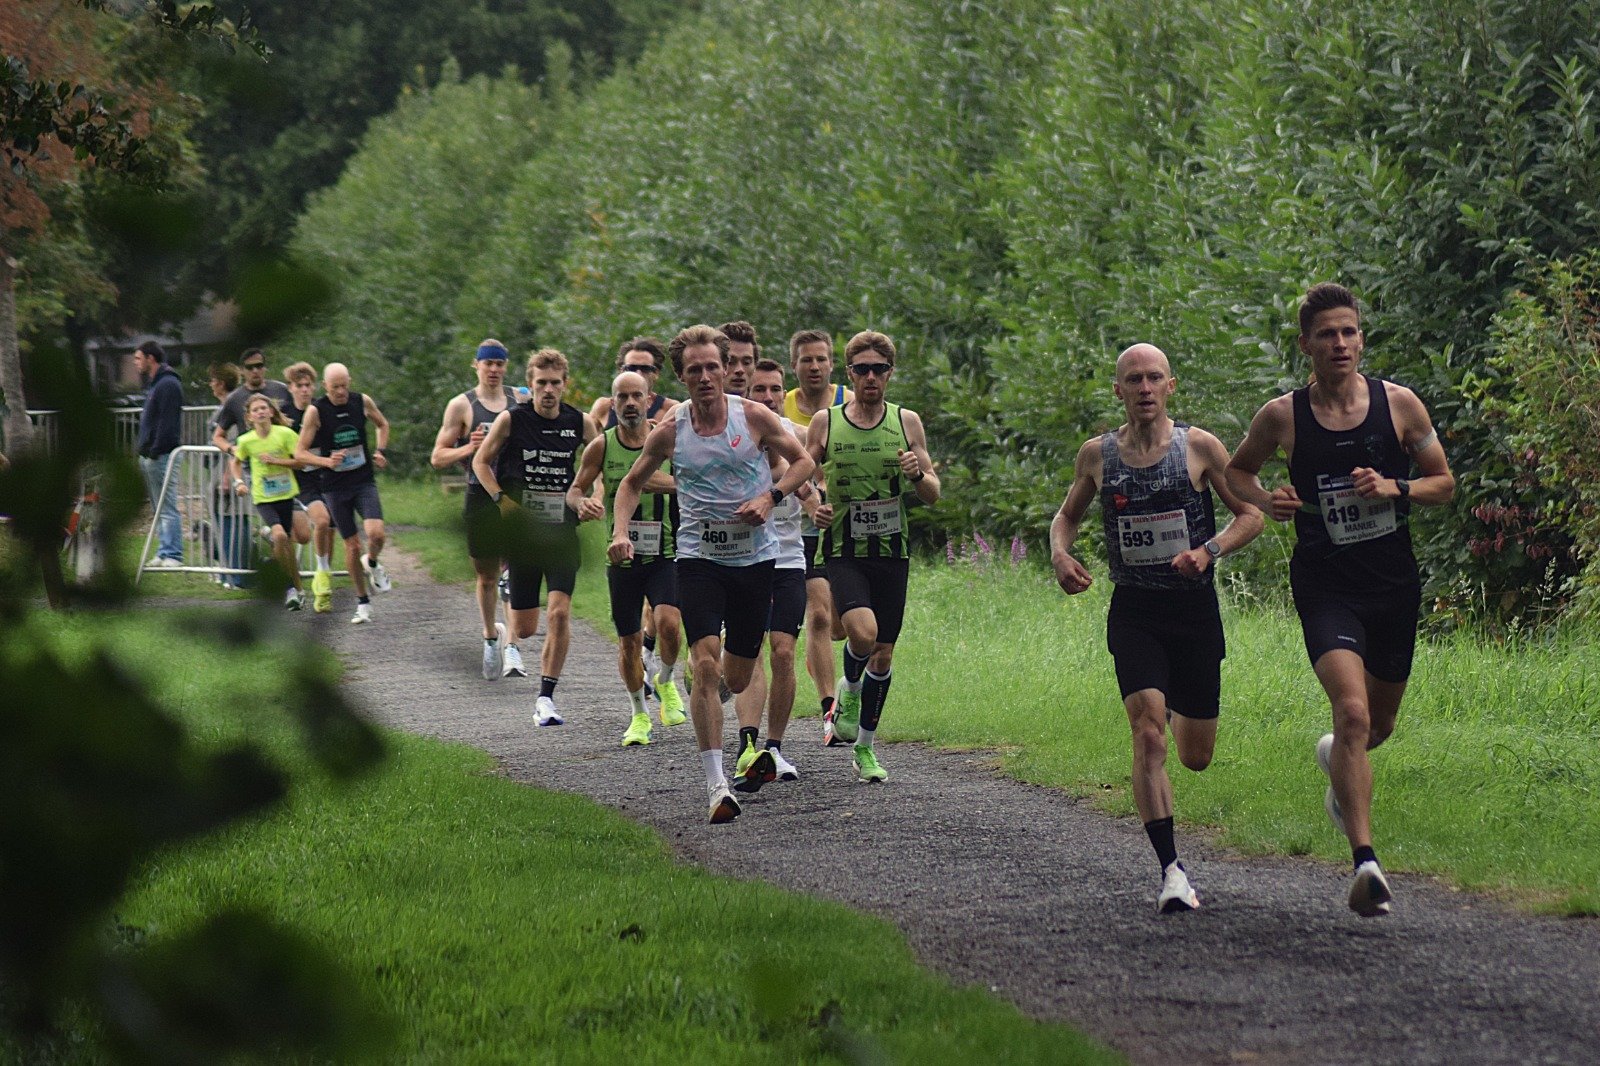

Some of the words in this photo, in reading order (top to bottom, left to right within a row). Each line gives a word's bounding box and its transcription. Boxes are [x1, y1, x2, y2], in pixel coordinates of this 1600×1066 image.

[560, 429, 576, 437] ATK
[525, 464, 568, 475] BLACKROLL
[853, 511, 878, 524] 435
[1150, 511, 1184, 521] MARATHON
[1327, 504, 1360, 525] 419
[866, 522, 888, 531] STEVEN
[1344, 520, 1378, 533] MANUEL
[701, 530, 728, 544] 460
[1122, 530, 1155, 547] 593
